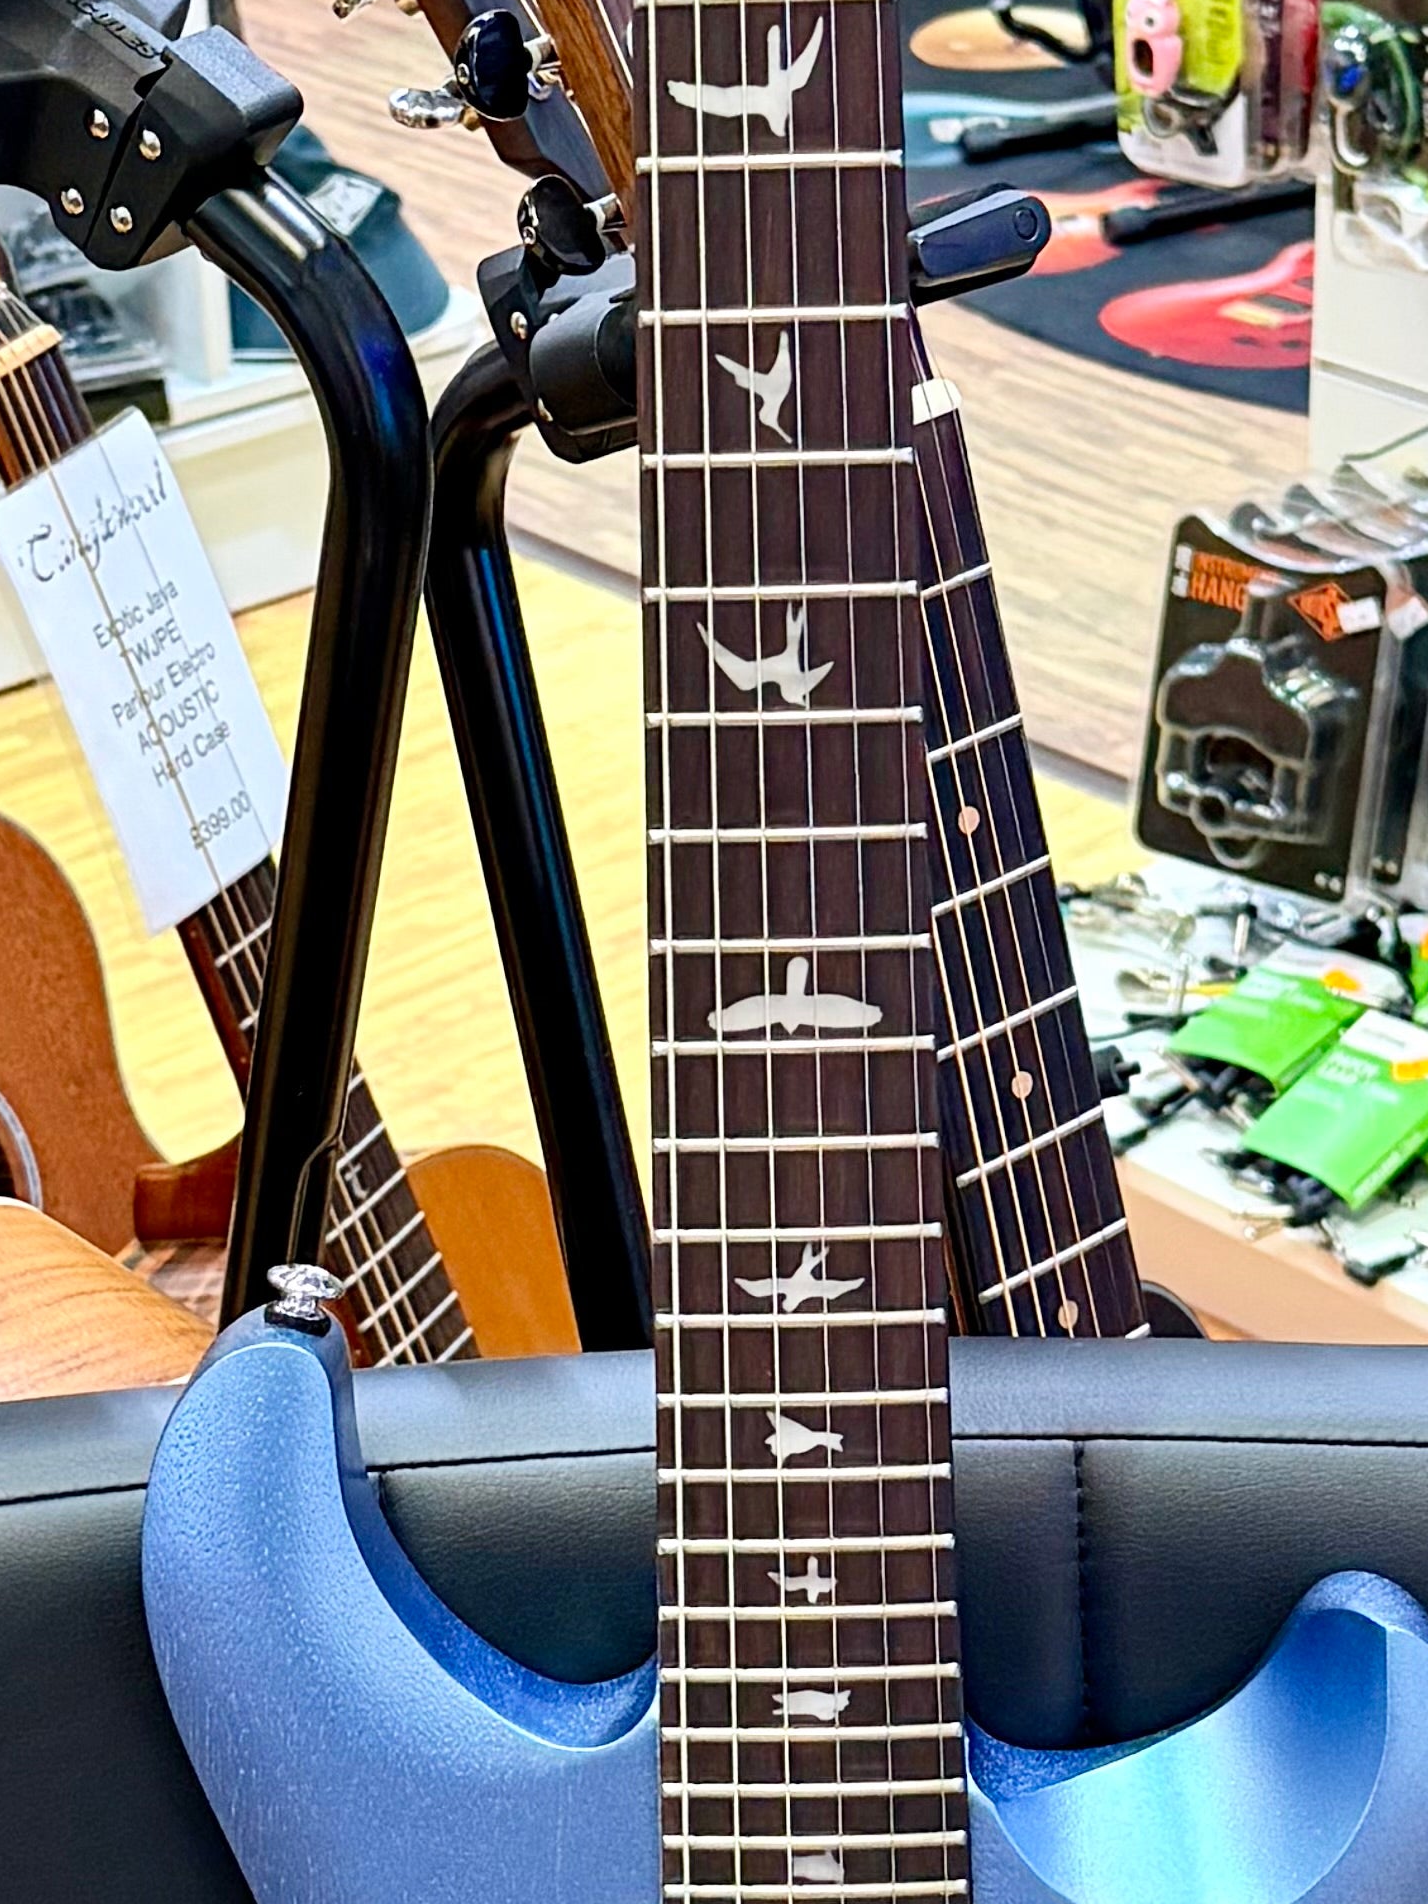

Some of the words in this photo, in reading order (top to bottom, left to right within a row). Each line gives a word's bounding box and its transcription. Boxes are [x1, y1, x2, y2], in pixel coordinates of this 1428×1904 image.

[1191, 570, 1249, 614] HANG
[93, 603, 144, 650] Exotic
[137, 678, 221, 756] ACOUSTIC
[193, 718, 231, 760] Case
